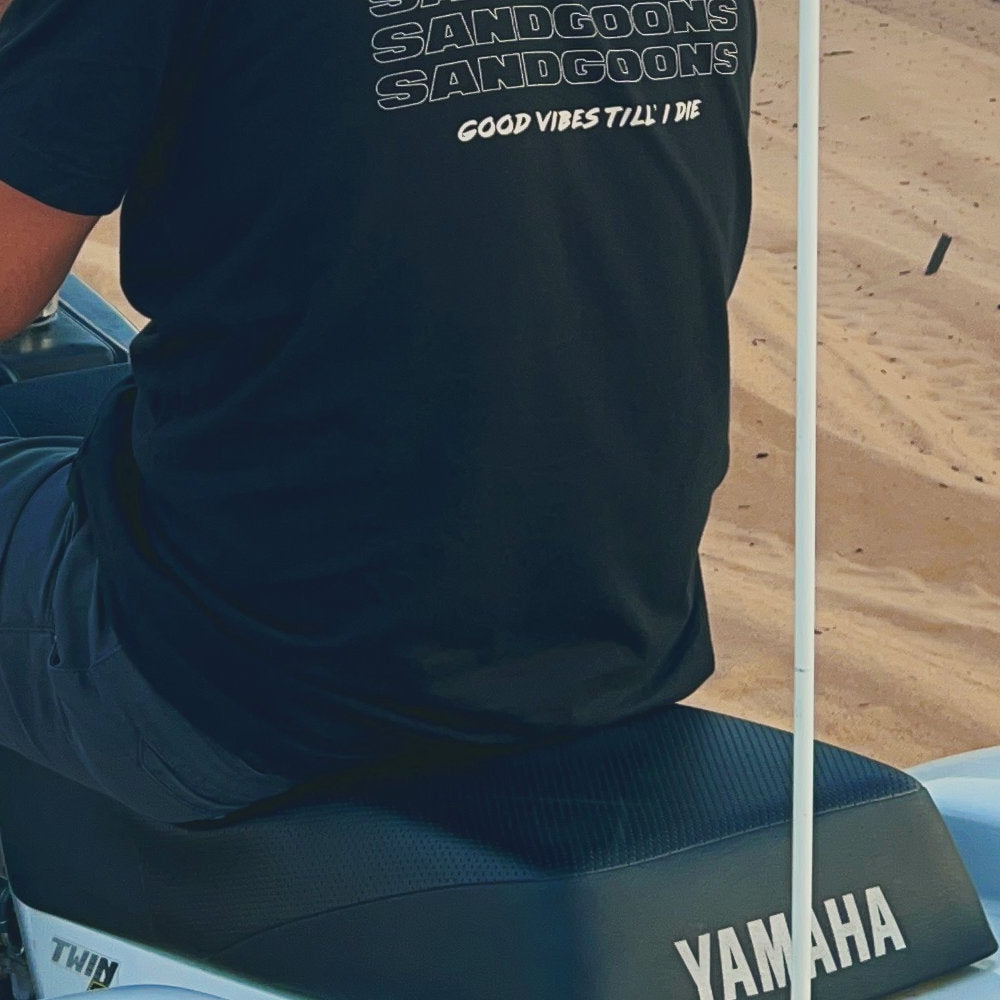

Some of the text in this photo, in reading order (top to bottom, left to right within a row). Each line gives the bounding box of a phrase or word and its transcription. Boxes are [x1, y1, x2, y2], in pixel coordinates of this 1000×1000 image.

[375, 41, 739, 110] SANDGOONS
[457, 112, 531, 142] GOOD
[535, 107, 600, 132] VIBES
[662, 103, 670, 124] I
[674, 99, 702, 123] DIE
[51, 936, 119, 989] TWIN
